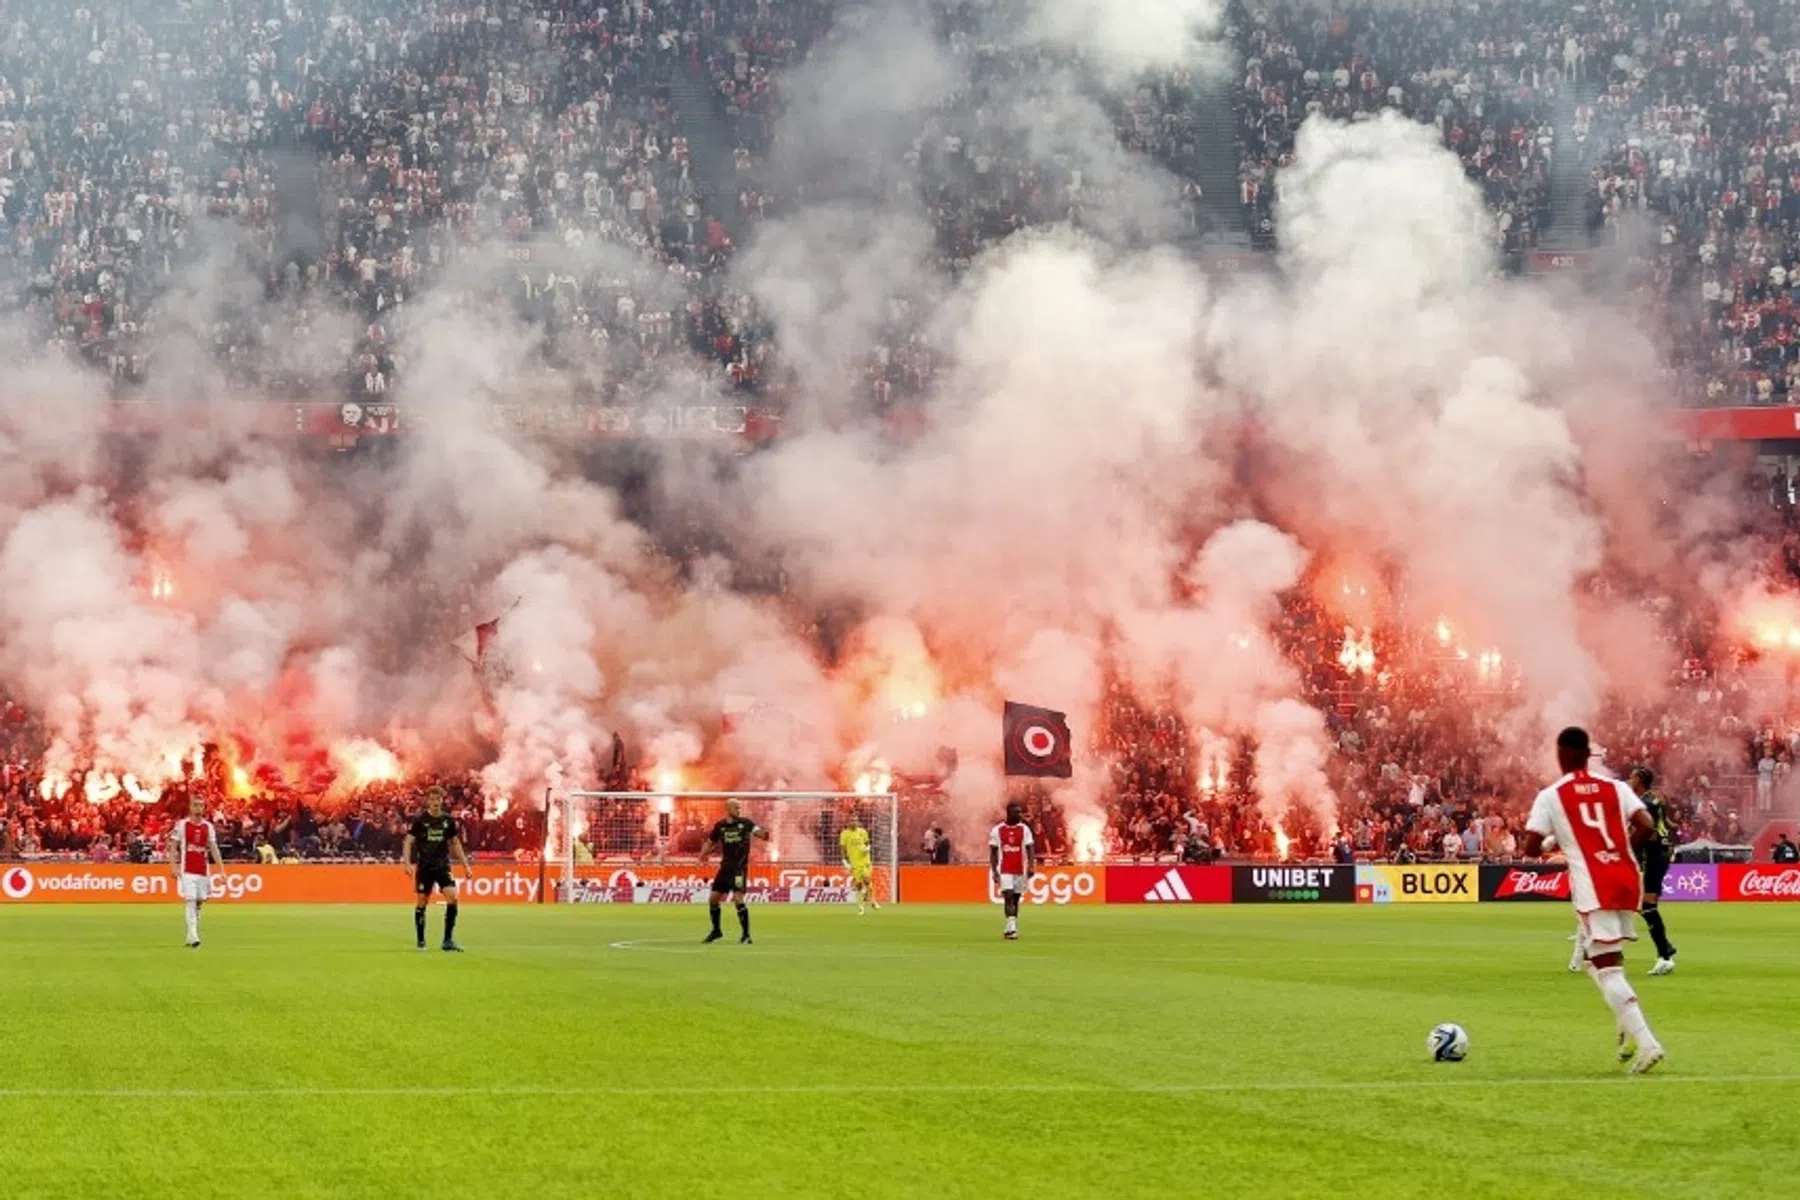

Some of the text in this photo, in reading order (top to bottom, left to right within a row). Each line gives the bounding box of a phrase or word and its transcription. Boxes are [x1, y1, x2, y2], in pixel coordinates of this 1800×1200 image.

[1579, 802, 1616, 849] 4
[38, 873, 262, 898] vodafone en ggo
[433, 870, 541, 901] riority
[988, 868, 1095, 904] ggo
[1252, 869, 1334, 887] UNIBET
[1402, 873, 1468, 894] BLOX
[1509, 871, 1563, 893] Bud
